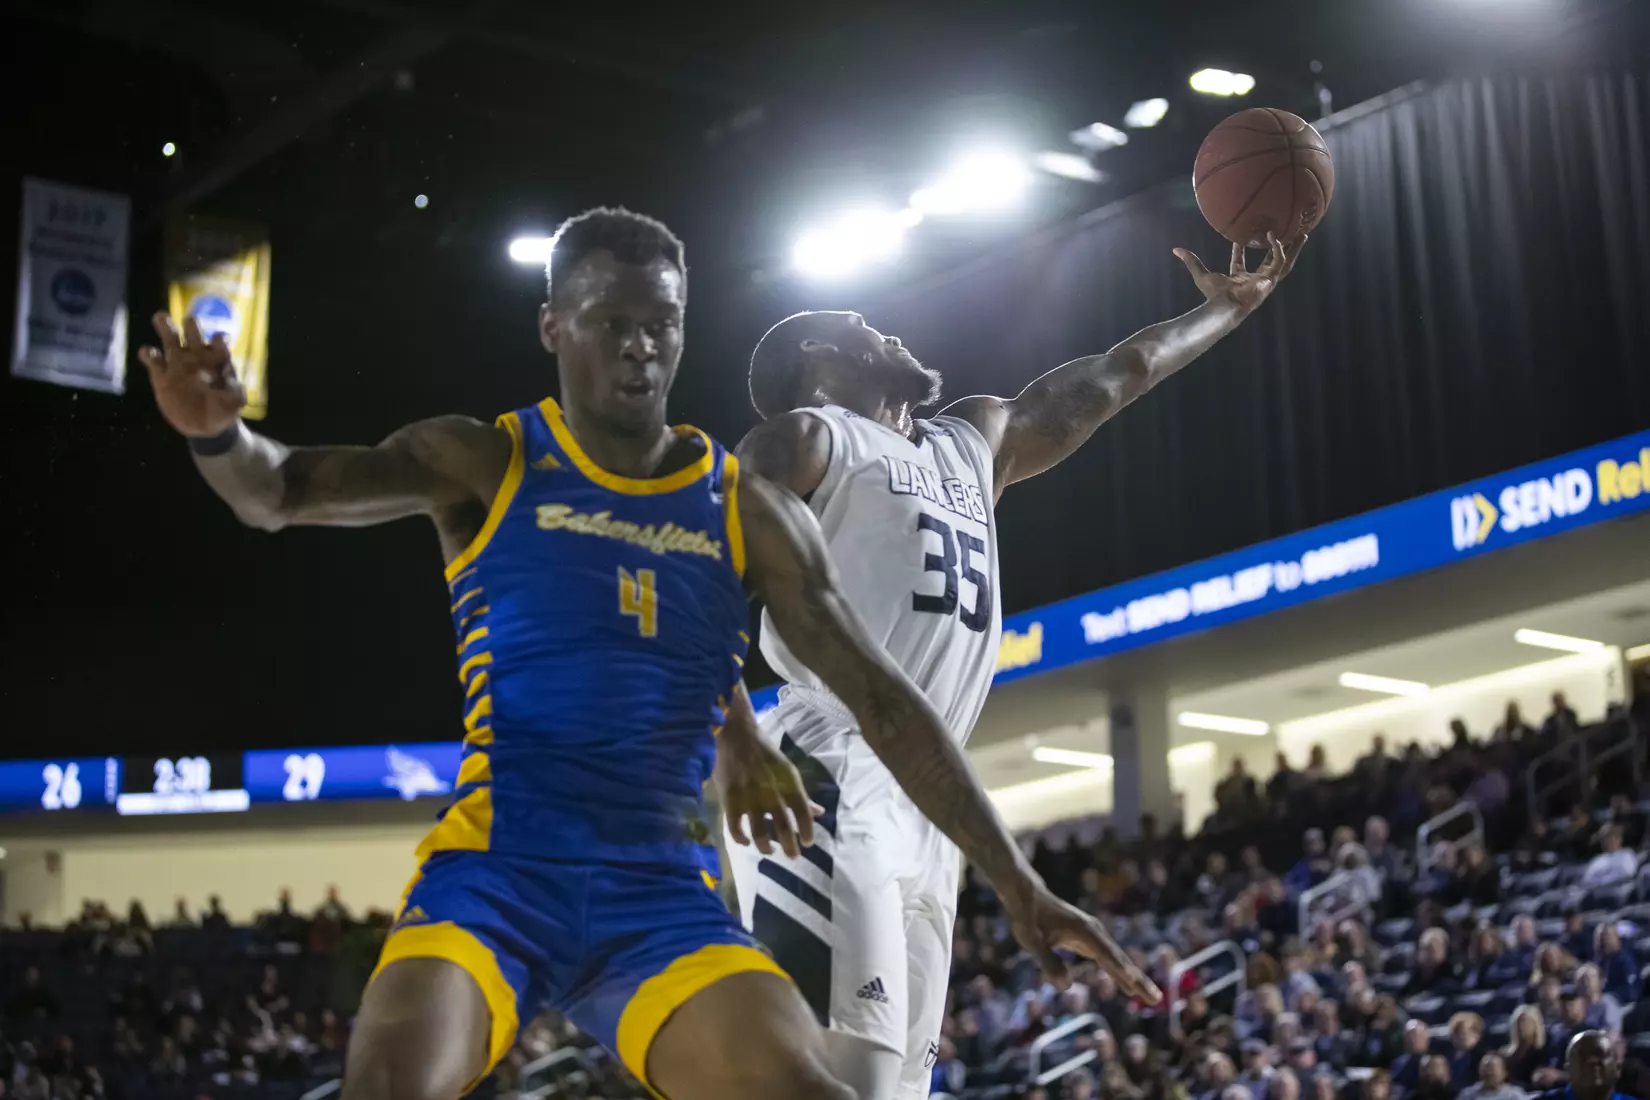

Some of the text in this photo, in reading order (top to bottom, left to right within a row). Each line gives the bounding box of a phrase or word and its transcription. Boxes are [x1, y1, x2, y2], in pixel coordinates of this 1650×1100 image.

[1499, 467, 1594, 533] SEND
[617, 564, 658, 637] 4
[912, 512, 990, 633] 35
[41, 762, 82, 810] 26
[283, 752, 327, 802] 29
